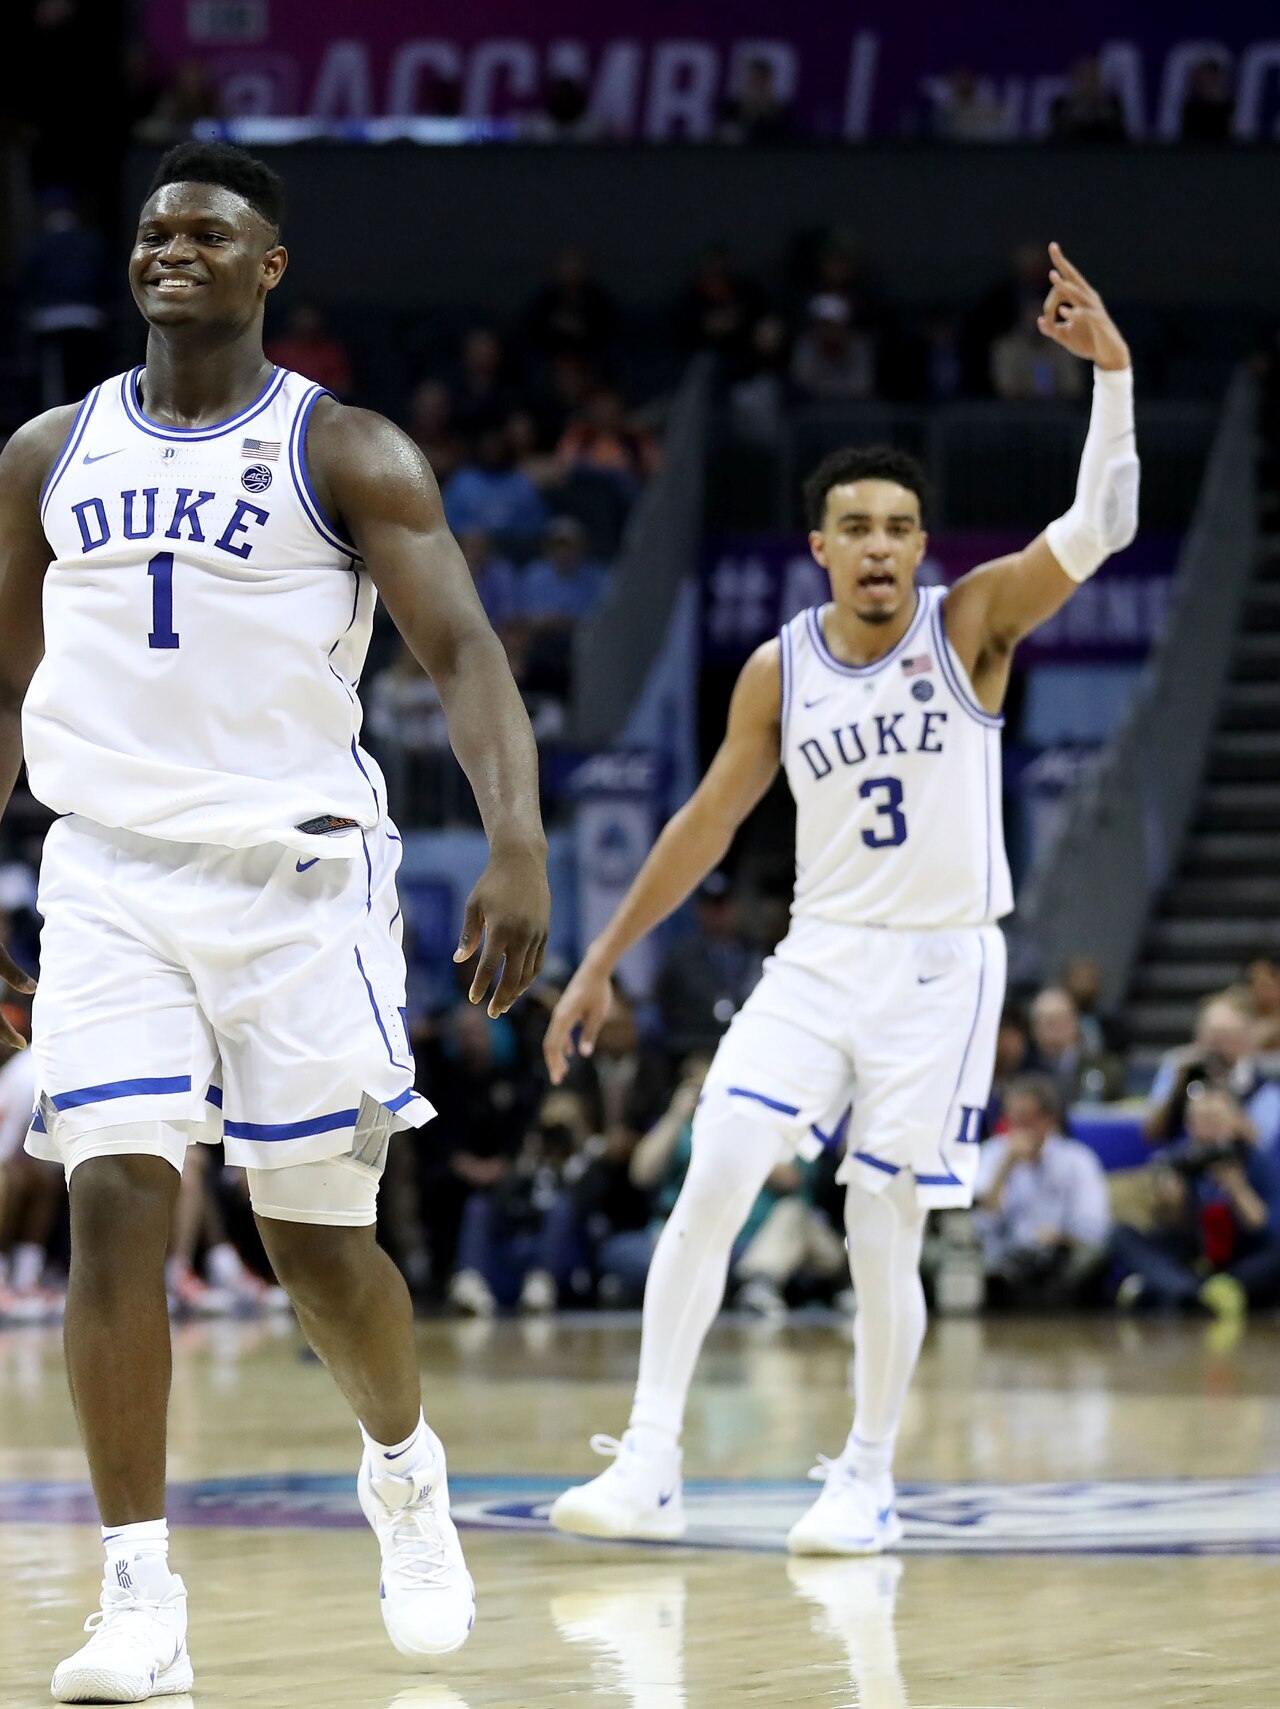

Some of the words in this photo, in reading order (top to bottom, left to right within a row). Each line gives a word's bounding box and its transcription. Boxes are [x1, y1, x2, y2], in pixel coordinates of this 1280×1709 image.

[246, 472, 269, 482] ACC
[71, 488, 270, 560] DUKE
[147, 551, 180, 649] 1
[799, 712, 949, 780] DUKE
[859, 776, 908, 850] 3
